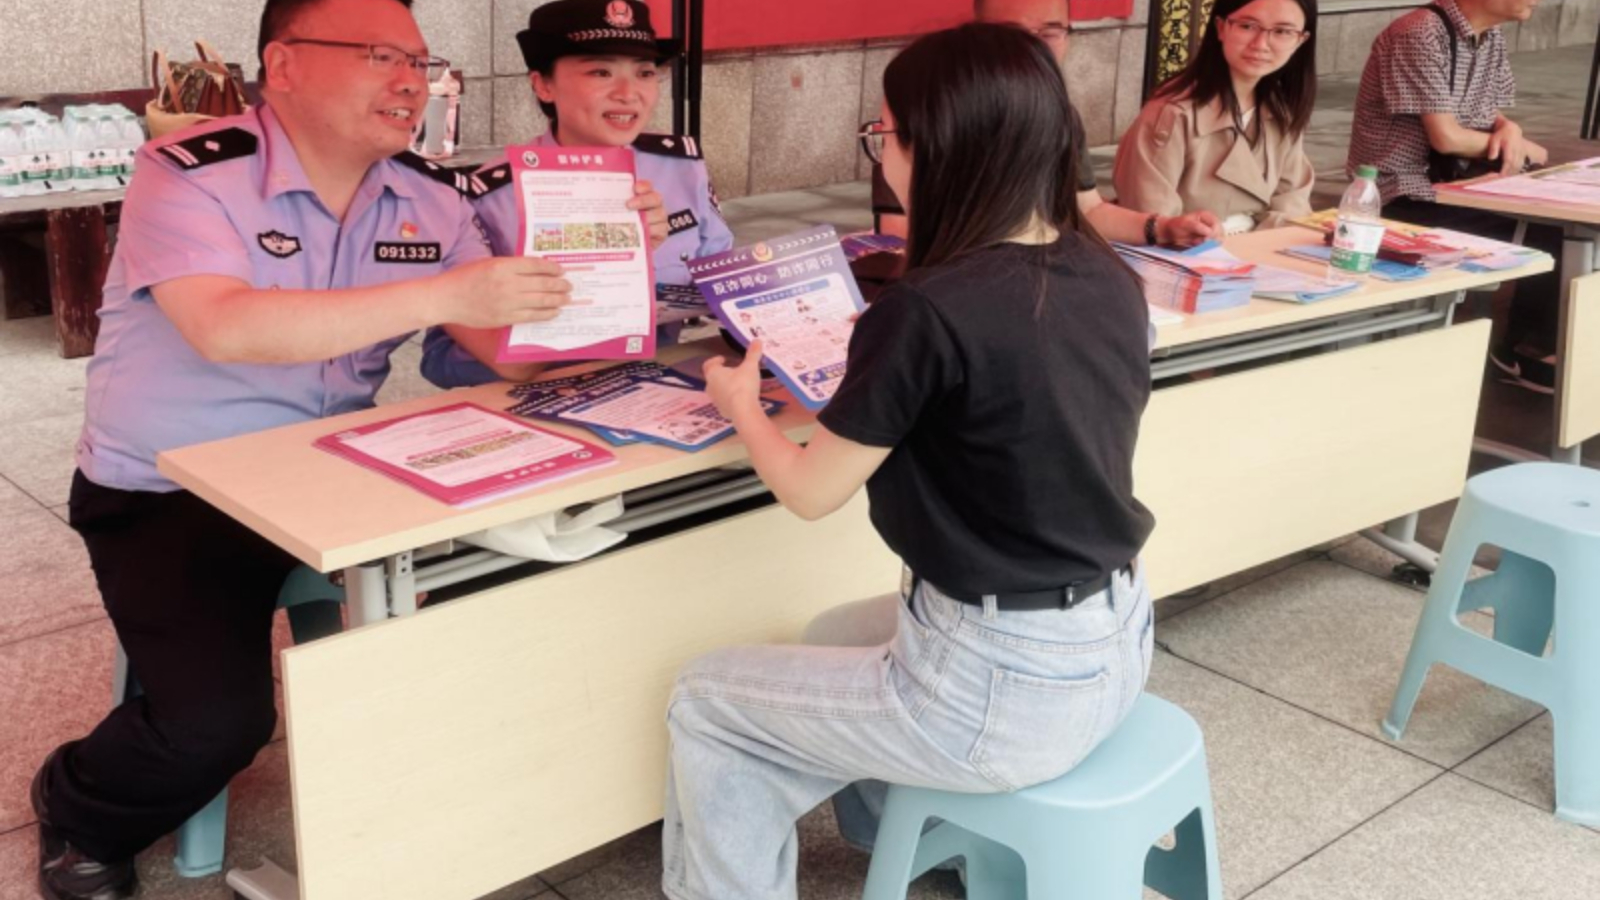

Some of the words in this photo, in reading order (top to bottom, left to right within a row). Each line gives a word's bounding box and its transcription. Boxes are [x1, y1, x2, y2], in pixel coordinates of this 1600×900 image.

[379, 246, 437, 258] 091332
[711, 272, 768, 296] 反诈同心
[776, 254, 834, 278] 防诈同行
